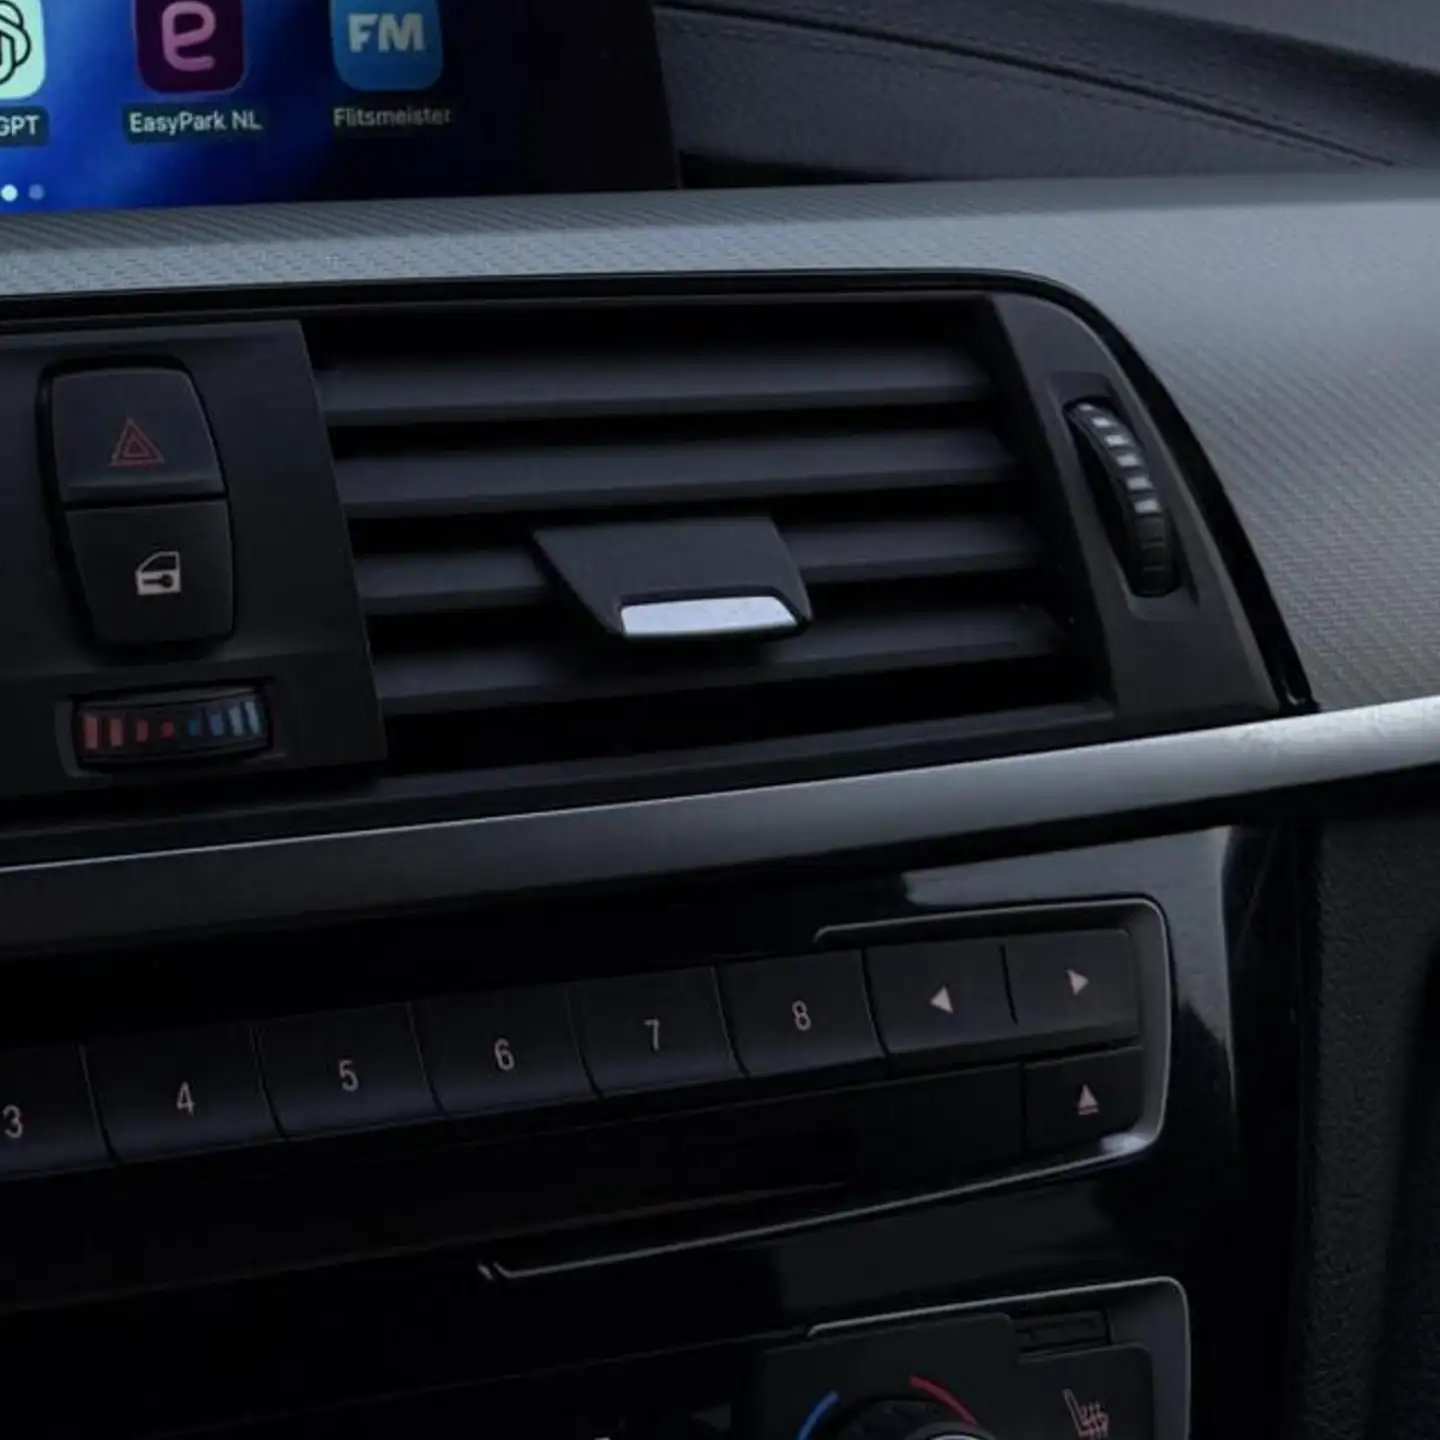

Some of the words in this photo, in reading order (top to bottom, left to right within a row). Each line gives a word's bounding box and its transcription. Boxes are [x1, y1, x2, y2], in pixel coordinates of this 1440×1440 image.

[347, 13, 426, 52] FM
[130, 112, 226, 134] EasyPark
[232, 112, 262, 131] NL
[333, 106, 451, 127] Flitsmeister
[792, 1001, 812, 1032] 8
[644, 1018, 662, 1051] 7
[495, 1039, 515, 1072] 6
[339, 1060, 358, 1093] 5
[177, 1082, 195, 1114] 4
[3, 1106, 22, 1138] 3
